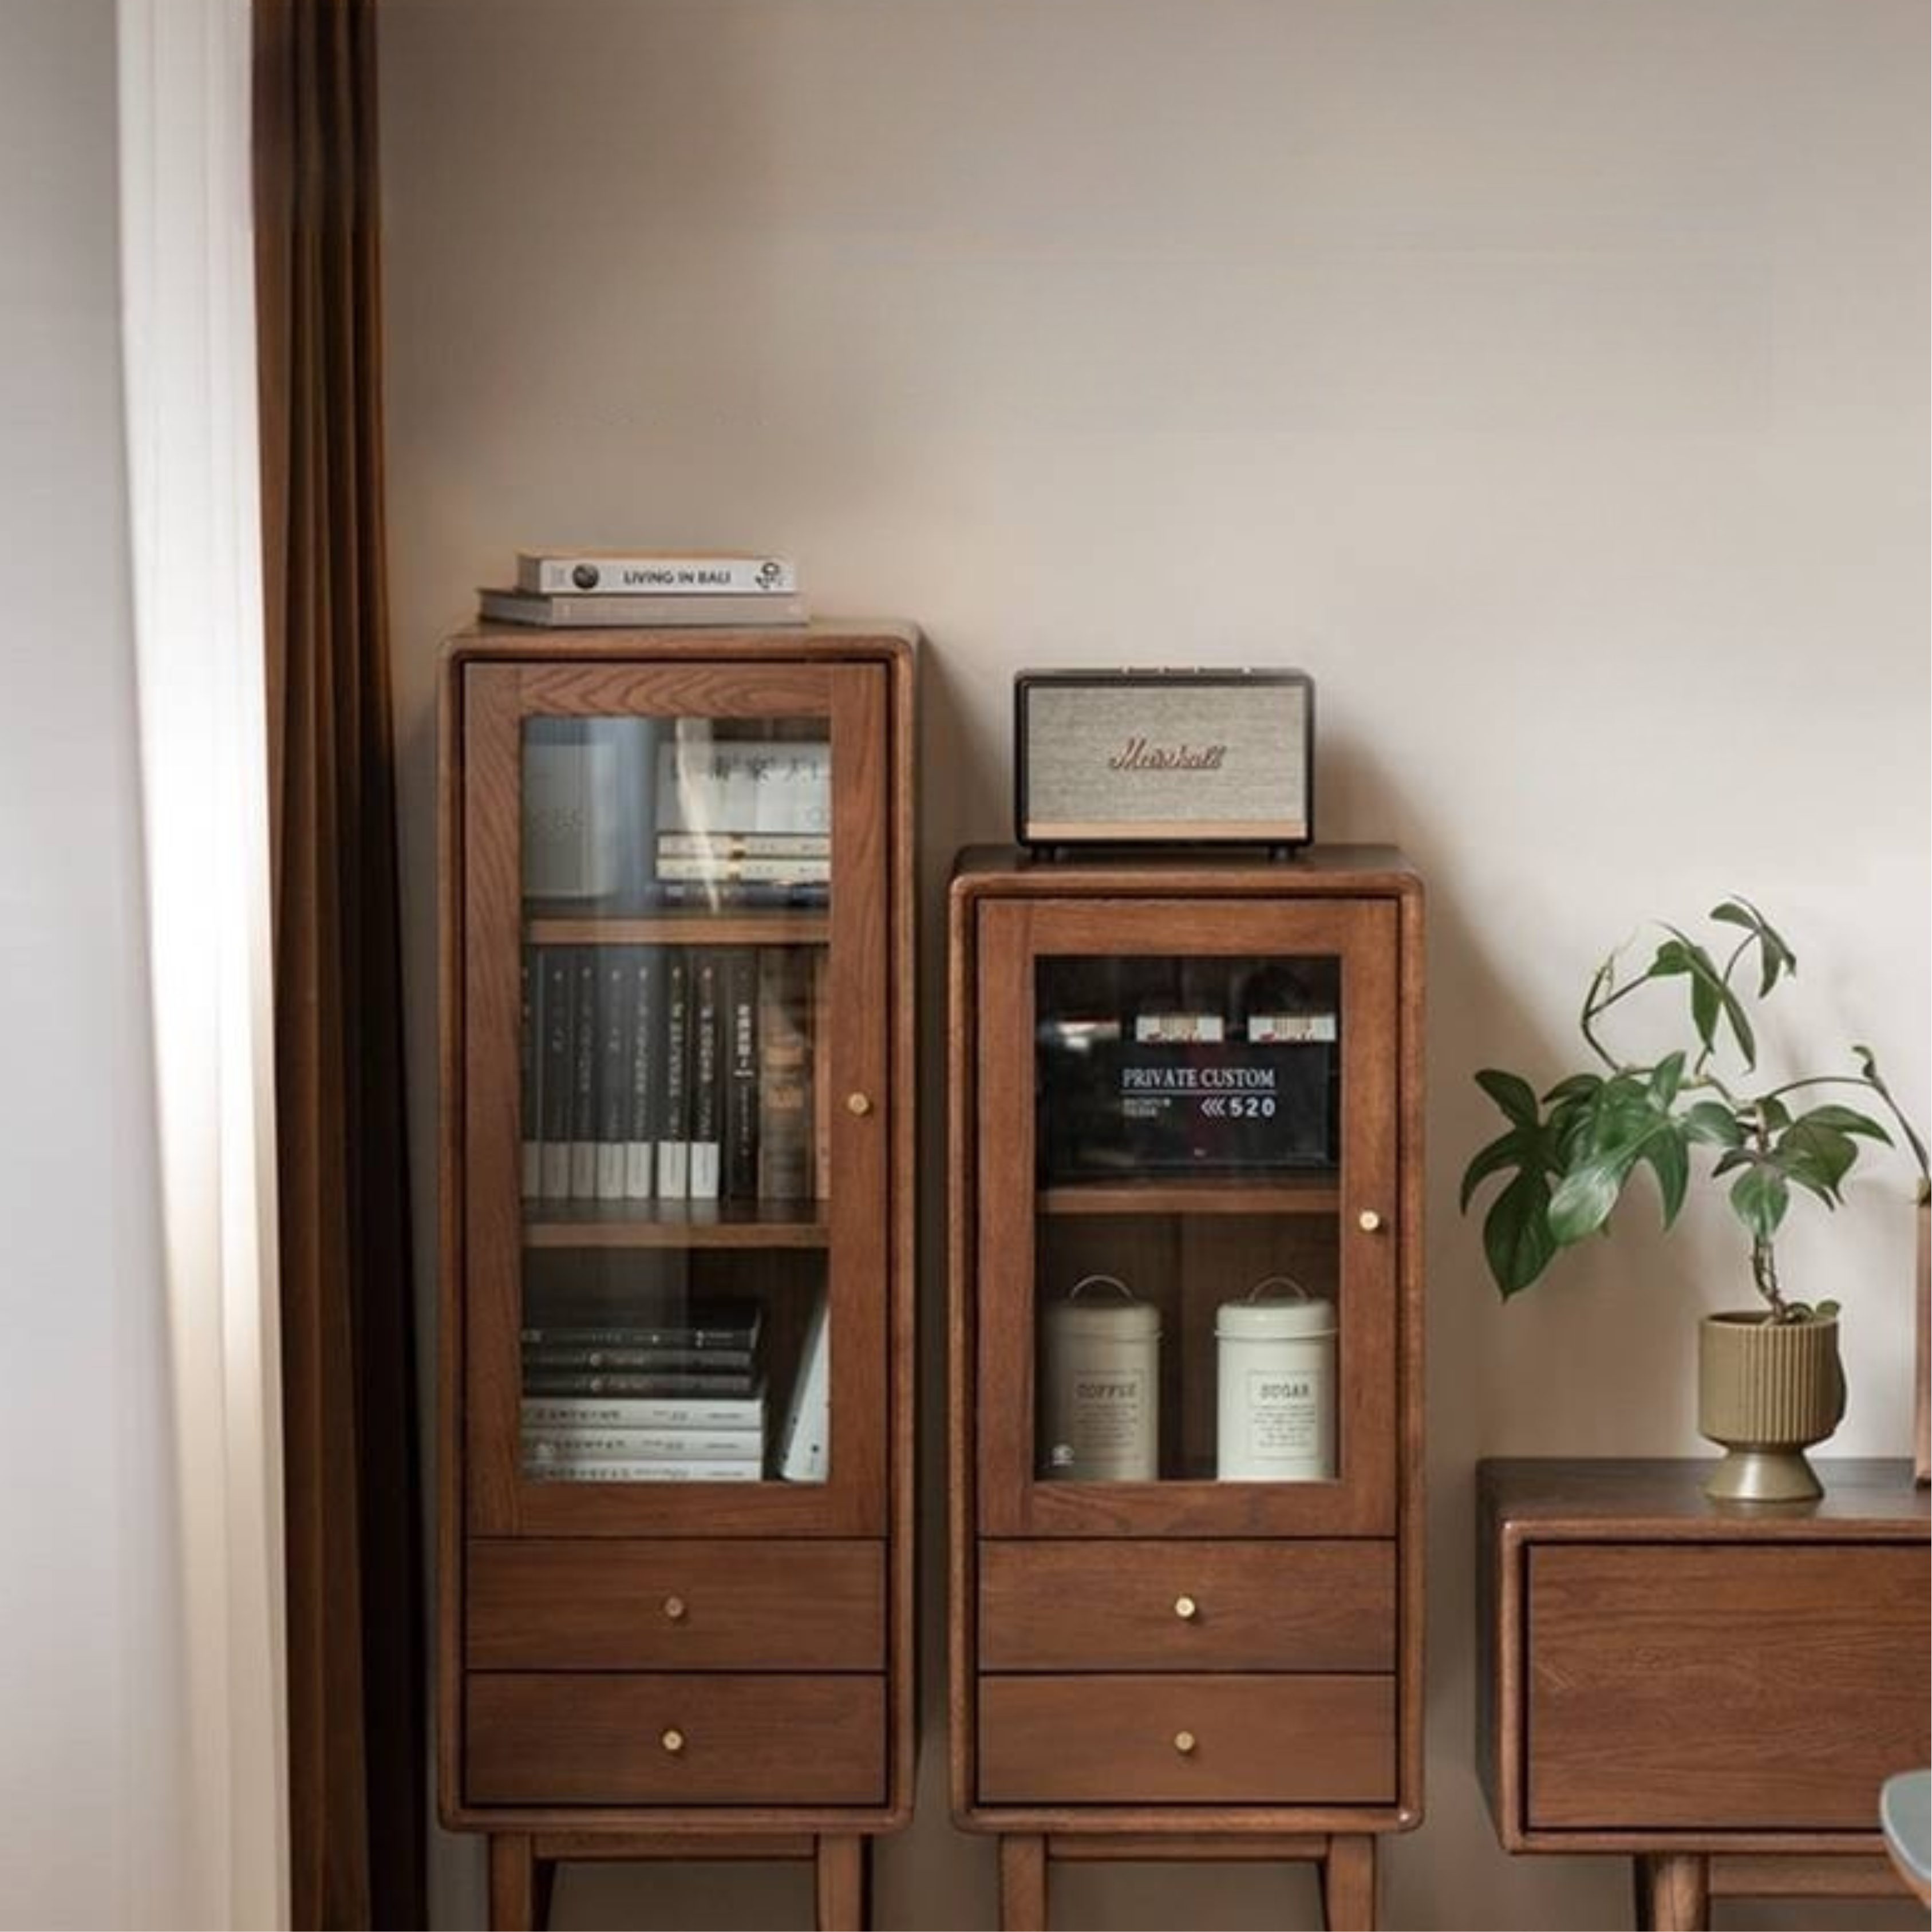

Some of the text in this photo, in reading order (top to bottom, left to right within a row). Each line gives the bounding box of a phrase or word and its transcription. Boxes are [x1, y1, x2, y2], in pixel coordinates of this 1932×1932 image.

[623, 571, 732, 584] LIVING IN BALI
[1109, 737, 1228, 771] Marshall
[1123, 1068, 1276, 1088] PRIVATE CUSTOM
[1231, 1097, 1276, 1118] 520
[1259, 1382, 1310, 1400] SUGAR
